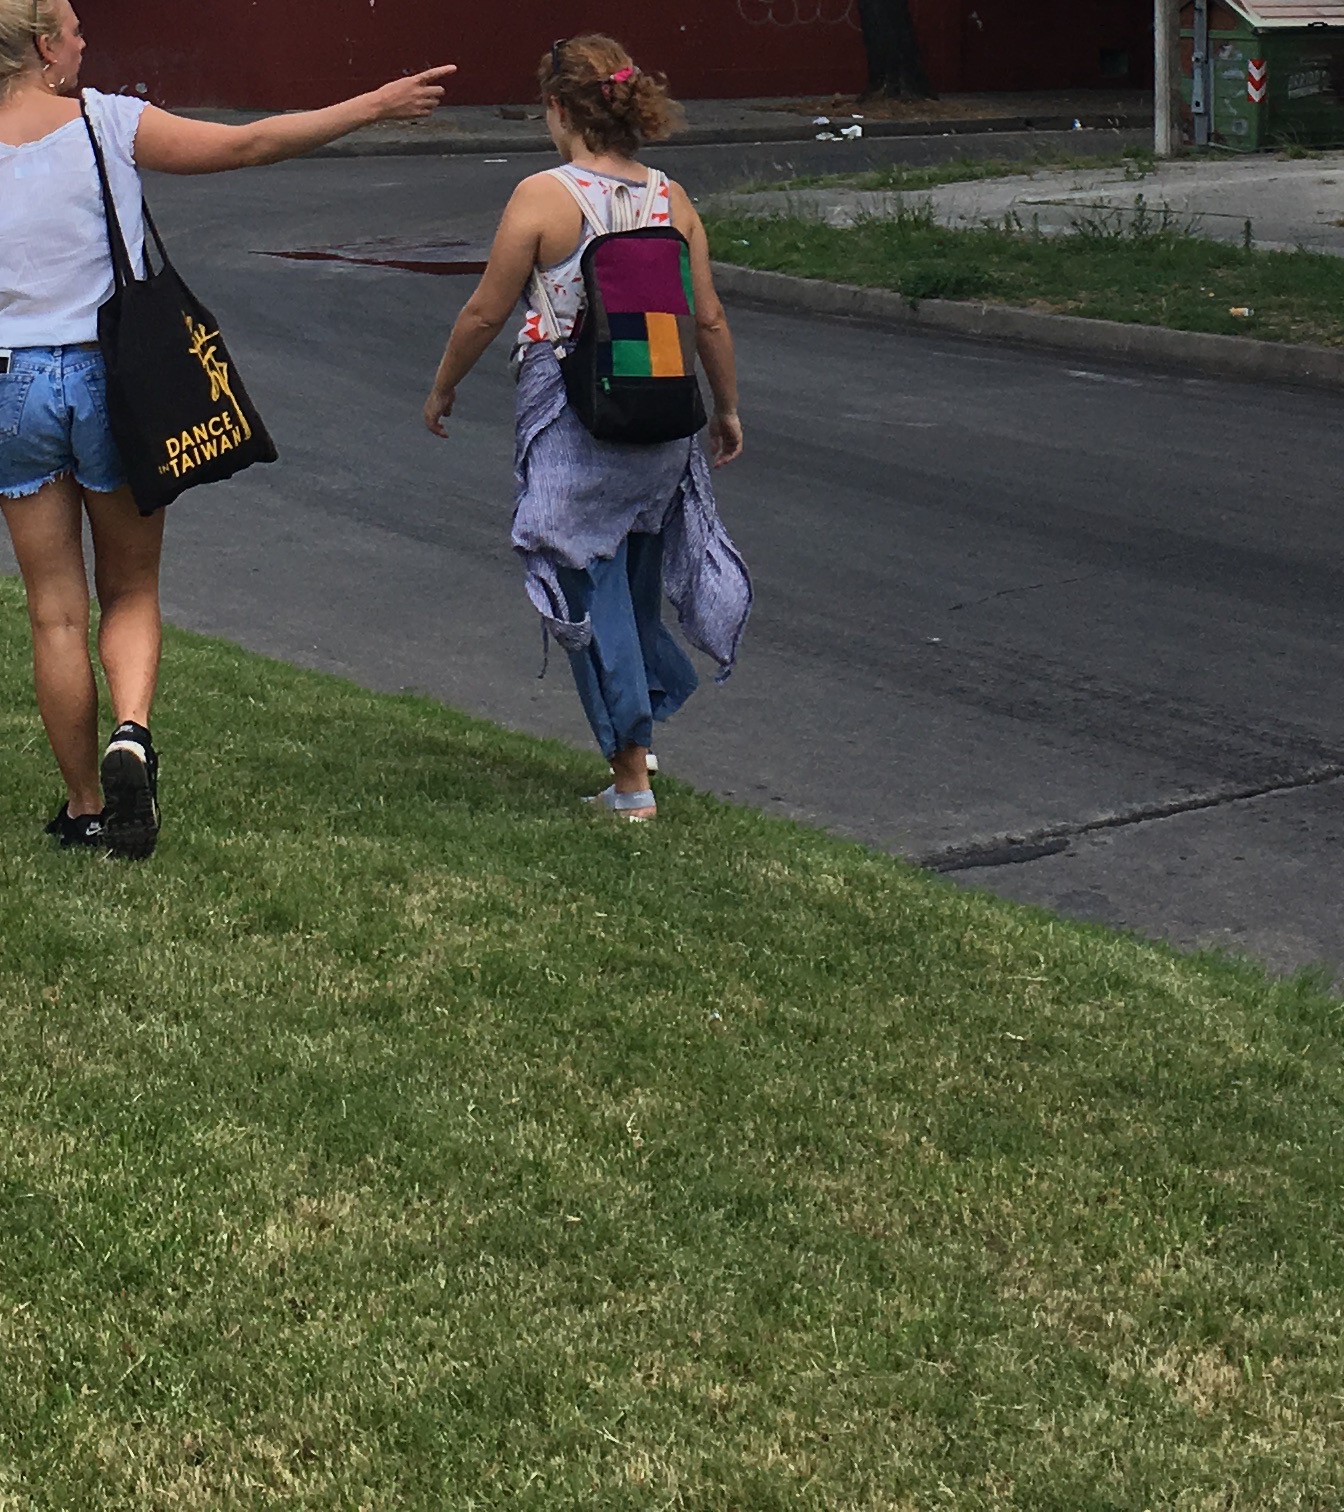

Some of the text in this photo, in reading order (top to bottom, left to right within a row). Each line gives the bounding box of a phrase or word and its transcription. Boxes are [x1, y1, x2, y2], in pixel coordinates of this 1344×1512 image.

[158, 426, 242, 478] IN TAIWAN
[165, 411, 233, 458] DANCE
